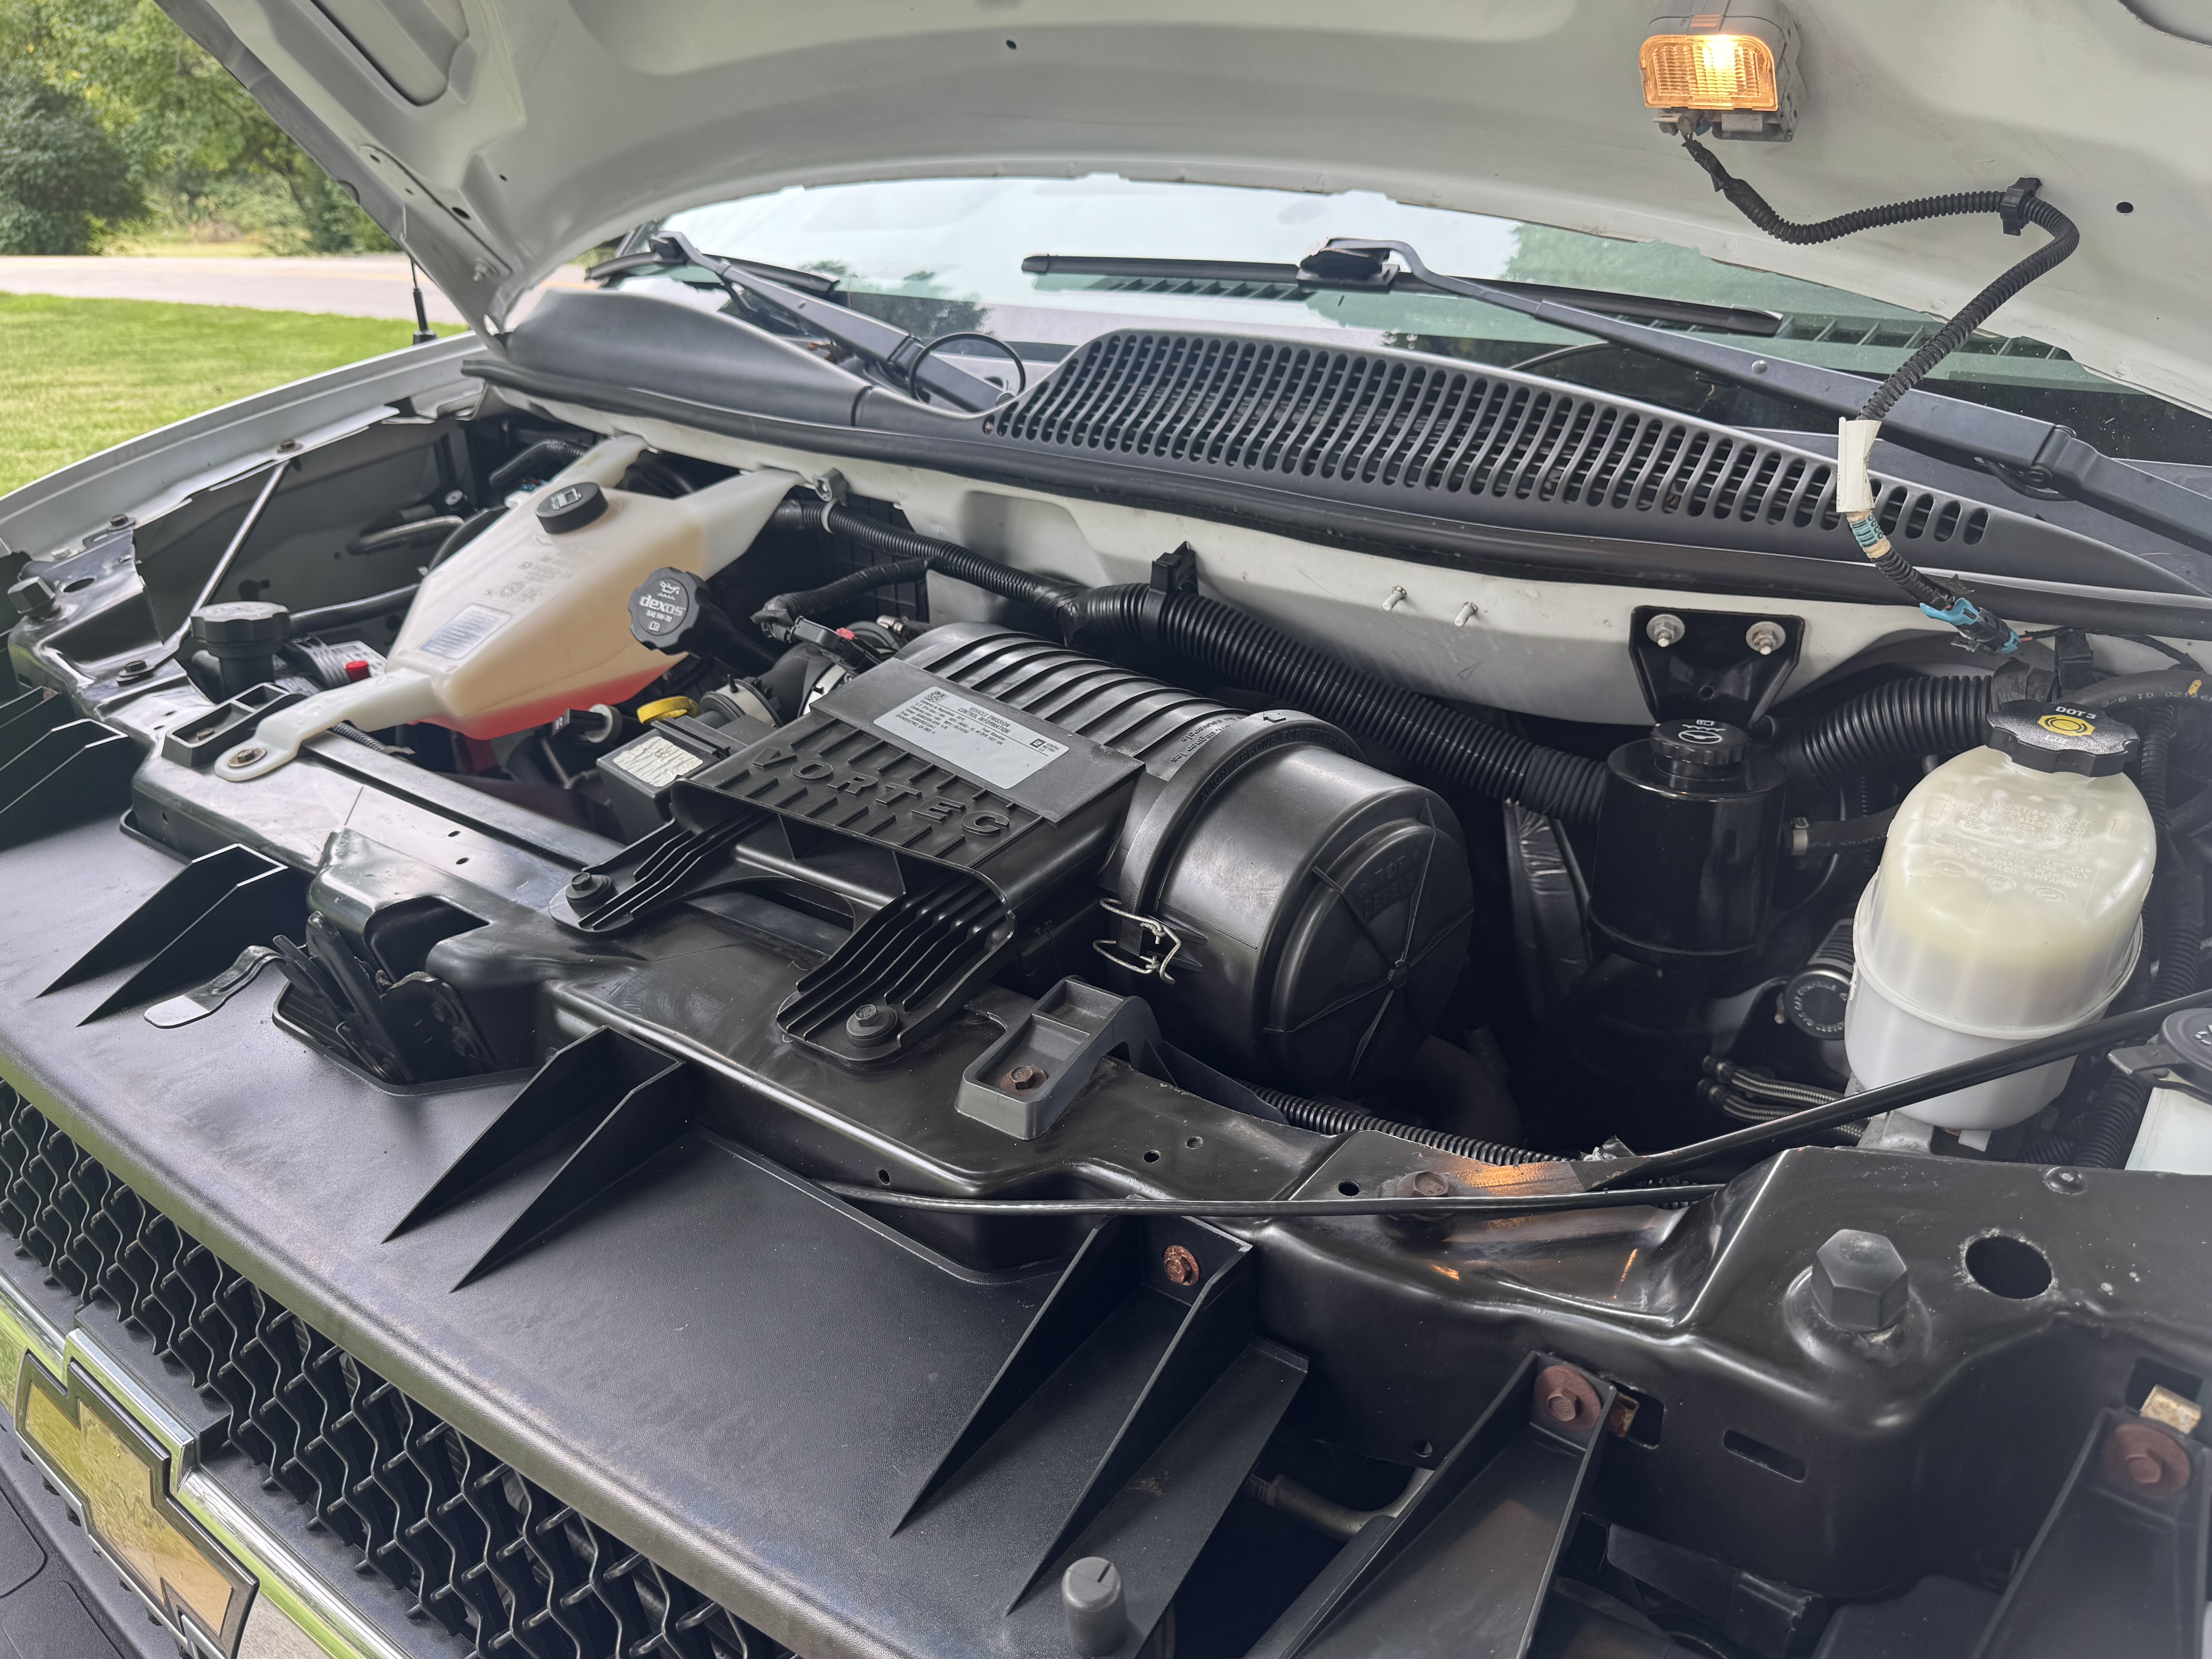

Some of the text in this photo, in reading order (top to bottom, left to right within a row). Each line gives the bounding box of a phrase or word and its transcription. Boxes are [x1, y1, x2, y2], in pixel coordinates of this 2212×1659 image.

[640, 594, 685, 617] dexos
[646, 610, 672, 622] SAE 5W-30
[2055, 706, 2086, 716] DOT
[2100, 696, 2127, 707] 3/8
[958, 708, 1011, 733] CONTROL INFORMATION
[969, 707, 1011, 728] VEHICLE EMISSION
[1200, 767, 1229, 802] ALIGN
[1234, 735, 1277, 769] ARROWS
[1280, 728, 1300, 742] FOR
[1304, 728, 1339, 746] PROPER
[752, 747, 1010, 836] VORTEC
[1993, 857, 2029, 871] BRAKE
[2034, 868, 2066, 880] FLUID
[2033, 856, 2066, 868] FILLER
[2038, 863, 2058, 872] USE
[2063, 870, 2090, 879] ONLY
[1980, 860, 2018, 874] SEALED
[2023, 872, 2078, 889] CONTAINER
